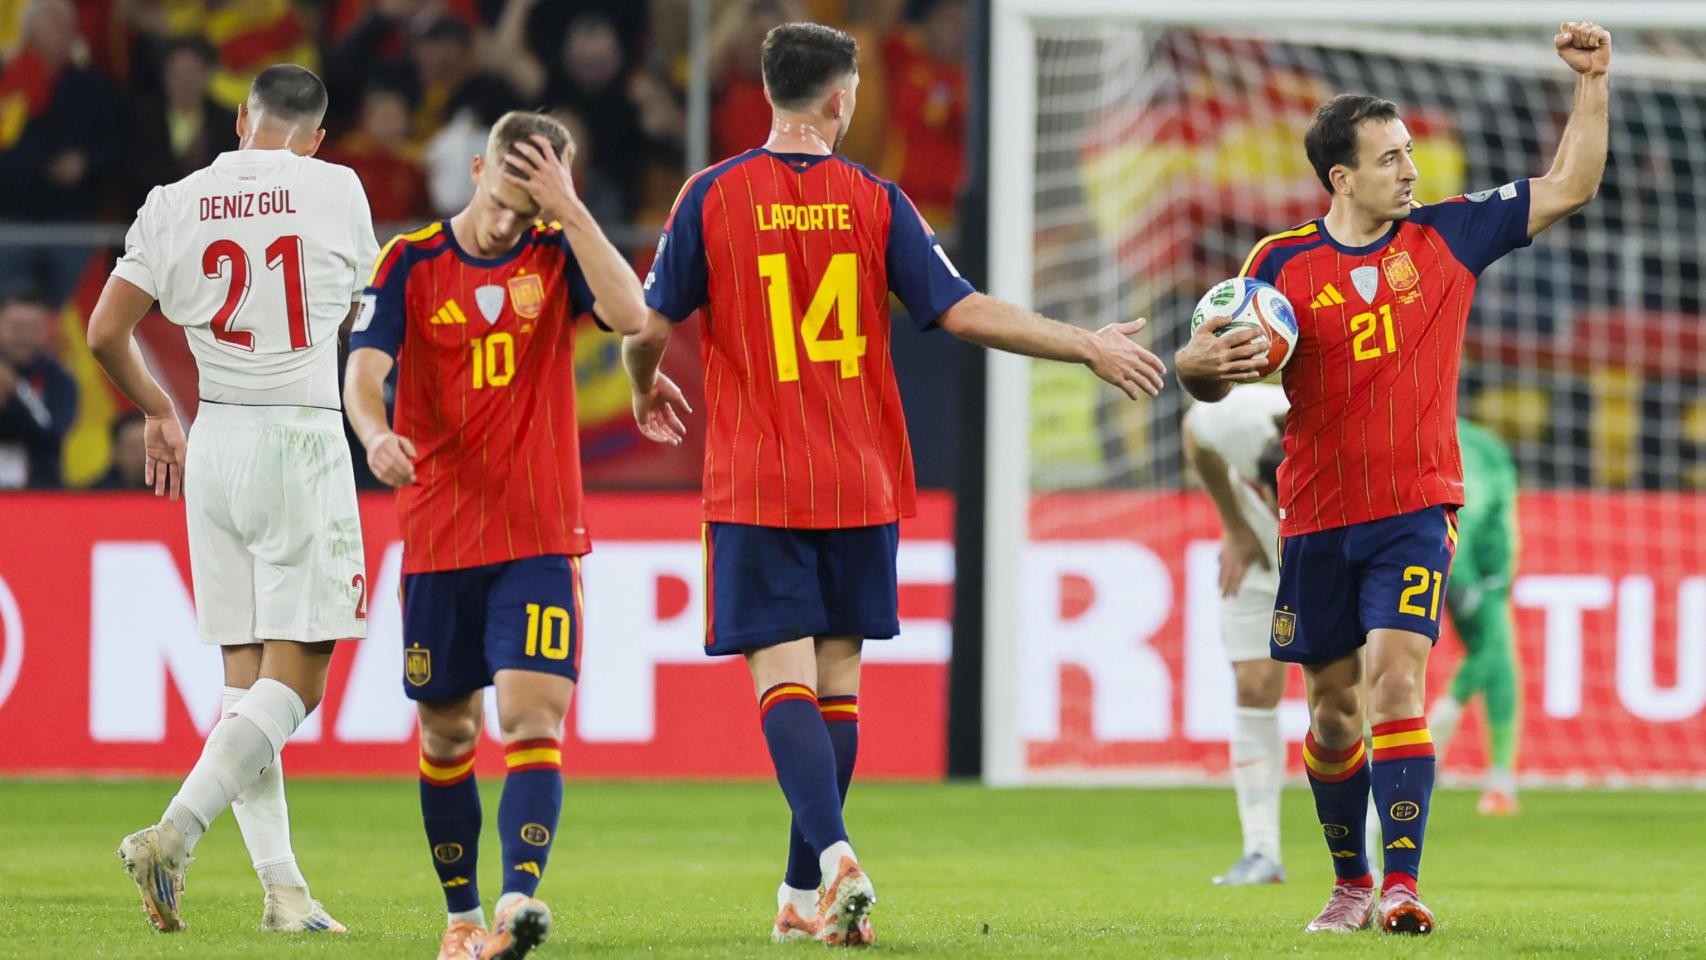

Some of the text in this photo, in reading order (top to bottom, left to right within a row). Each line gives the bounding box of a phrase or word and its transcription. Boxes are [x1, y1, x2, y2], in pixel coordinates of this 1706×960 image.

[200, 186, 296, 221] DENİZ GÜL
[756, 203, 851, 231] LAPORTE
[202, 235, 313, 352] 21
[758, 253, 867, 382] 14
[470, 332, 516, 389] 10
[1350, 303, 1397, 361] 21
[1399, 565, 1442, 621] 21
[525, 603, 570, 660] 10
[1513, 574, 1706, 722] TU
